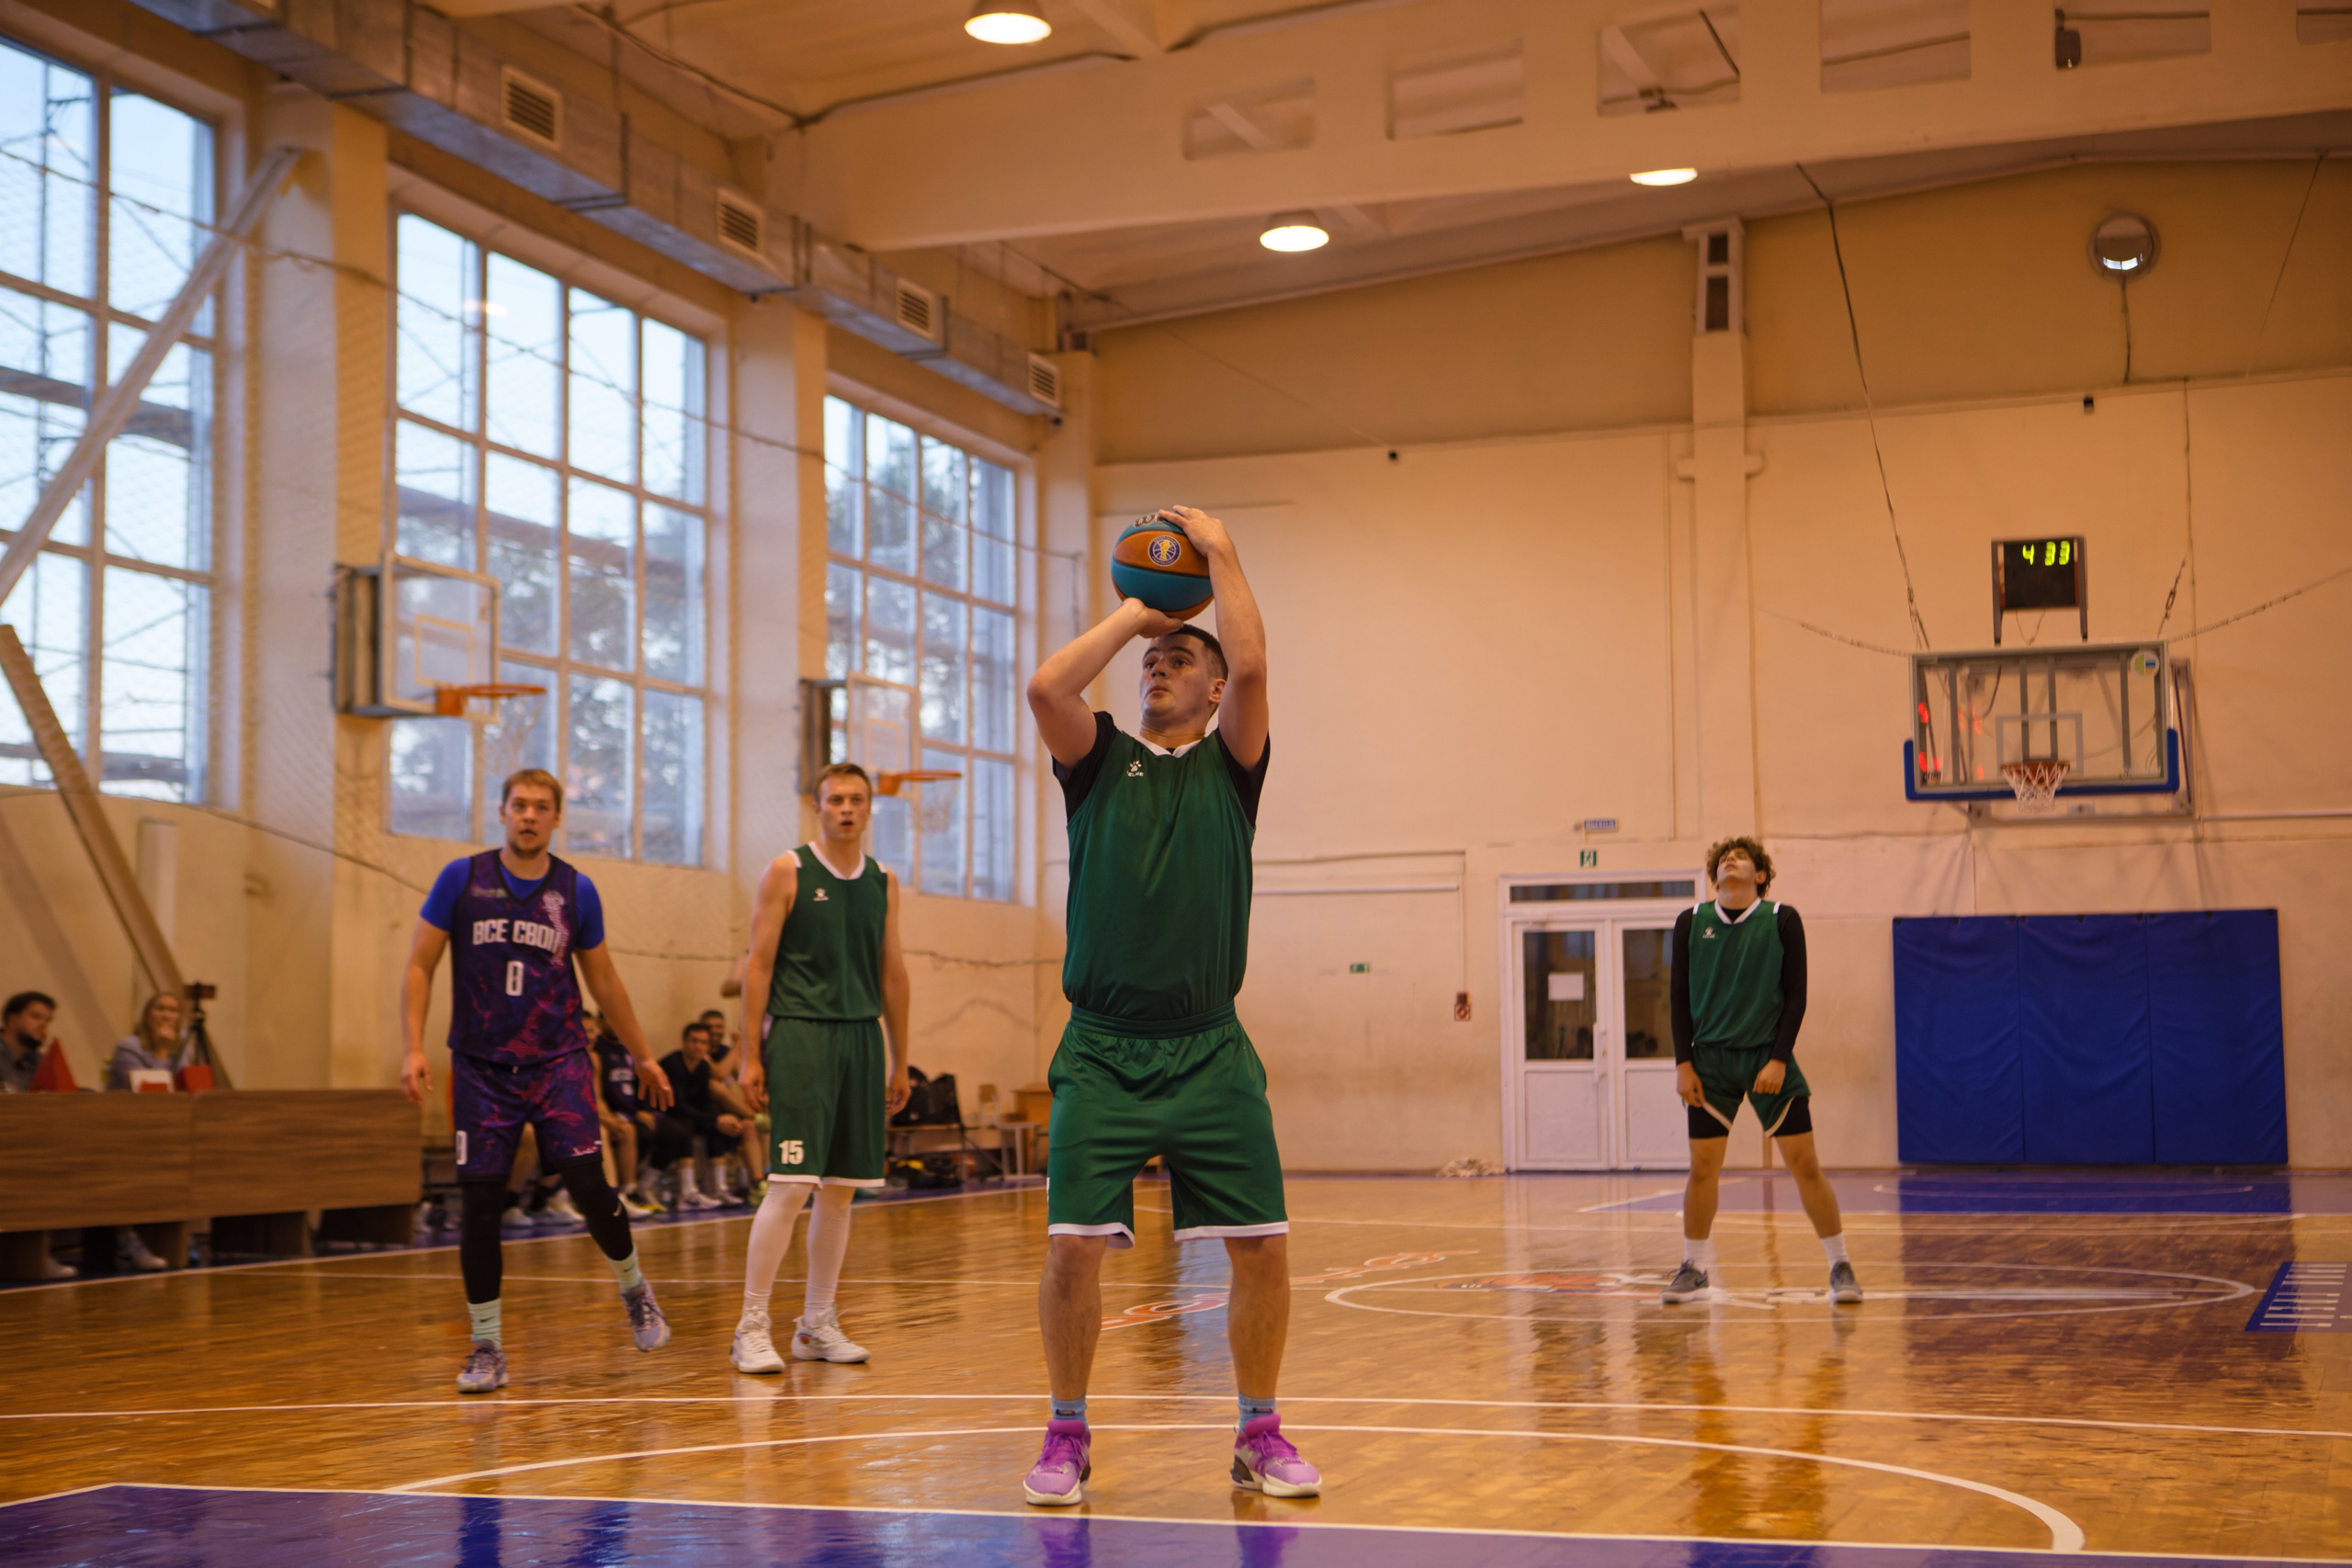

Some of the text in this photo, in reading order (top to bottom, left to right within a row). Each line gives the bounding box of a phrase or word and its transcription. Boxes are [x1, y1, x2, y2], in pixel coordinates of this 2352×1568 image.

[472, 919, 509, 945] ВСЕ
[505, 960, 525, 997] 0
[778, 1139, 804, 1165] 15
